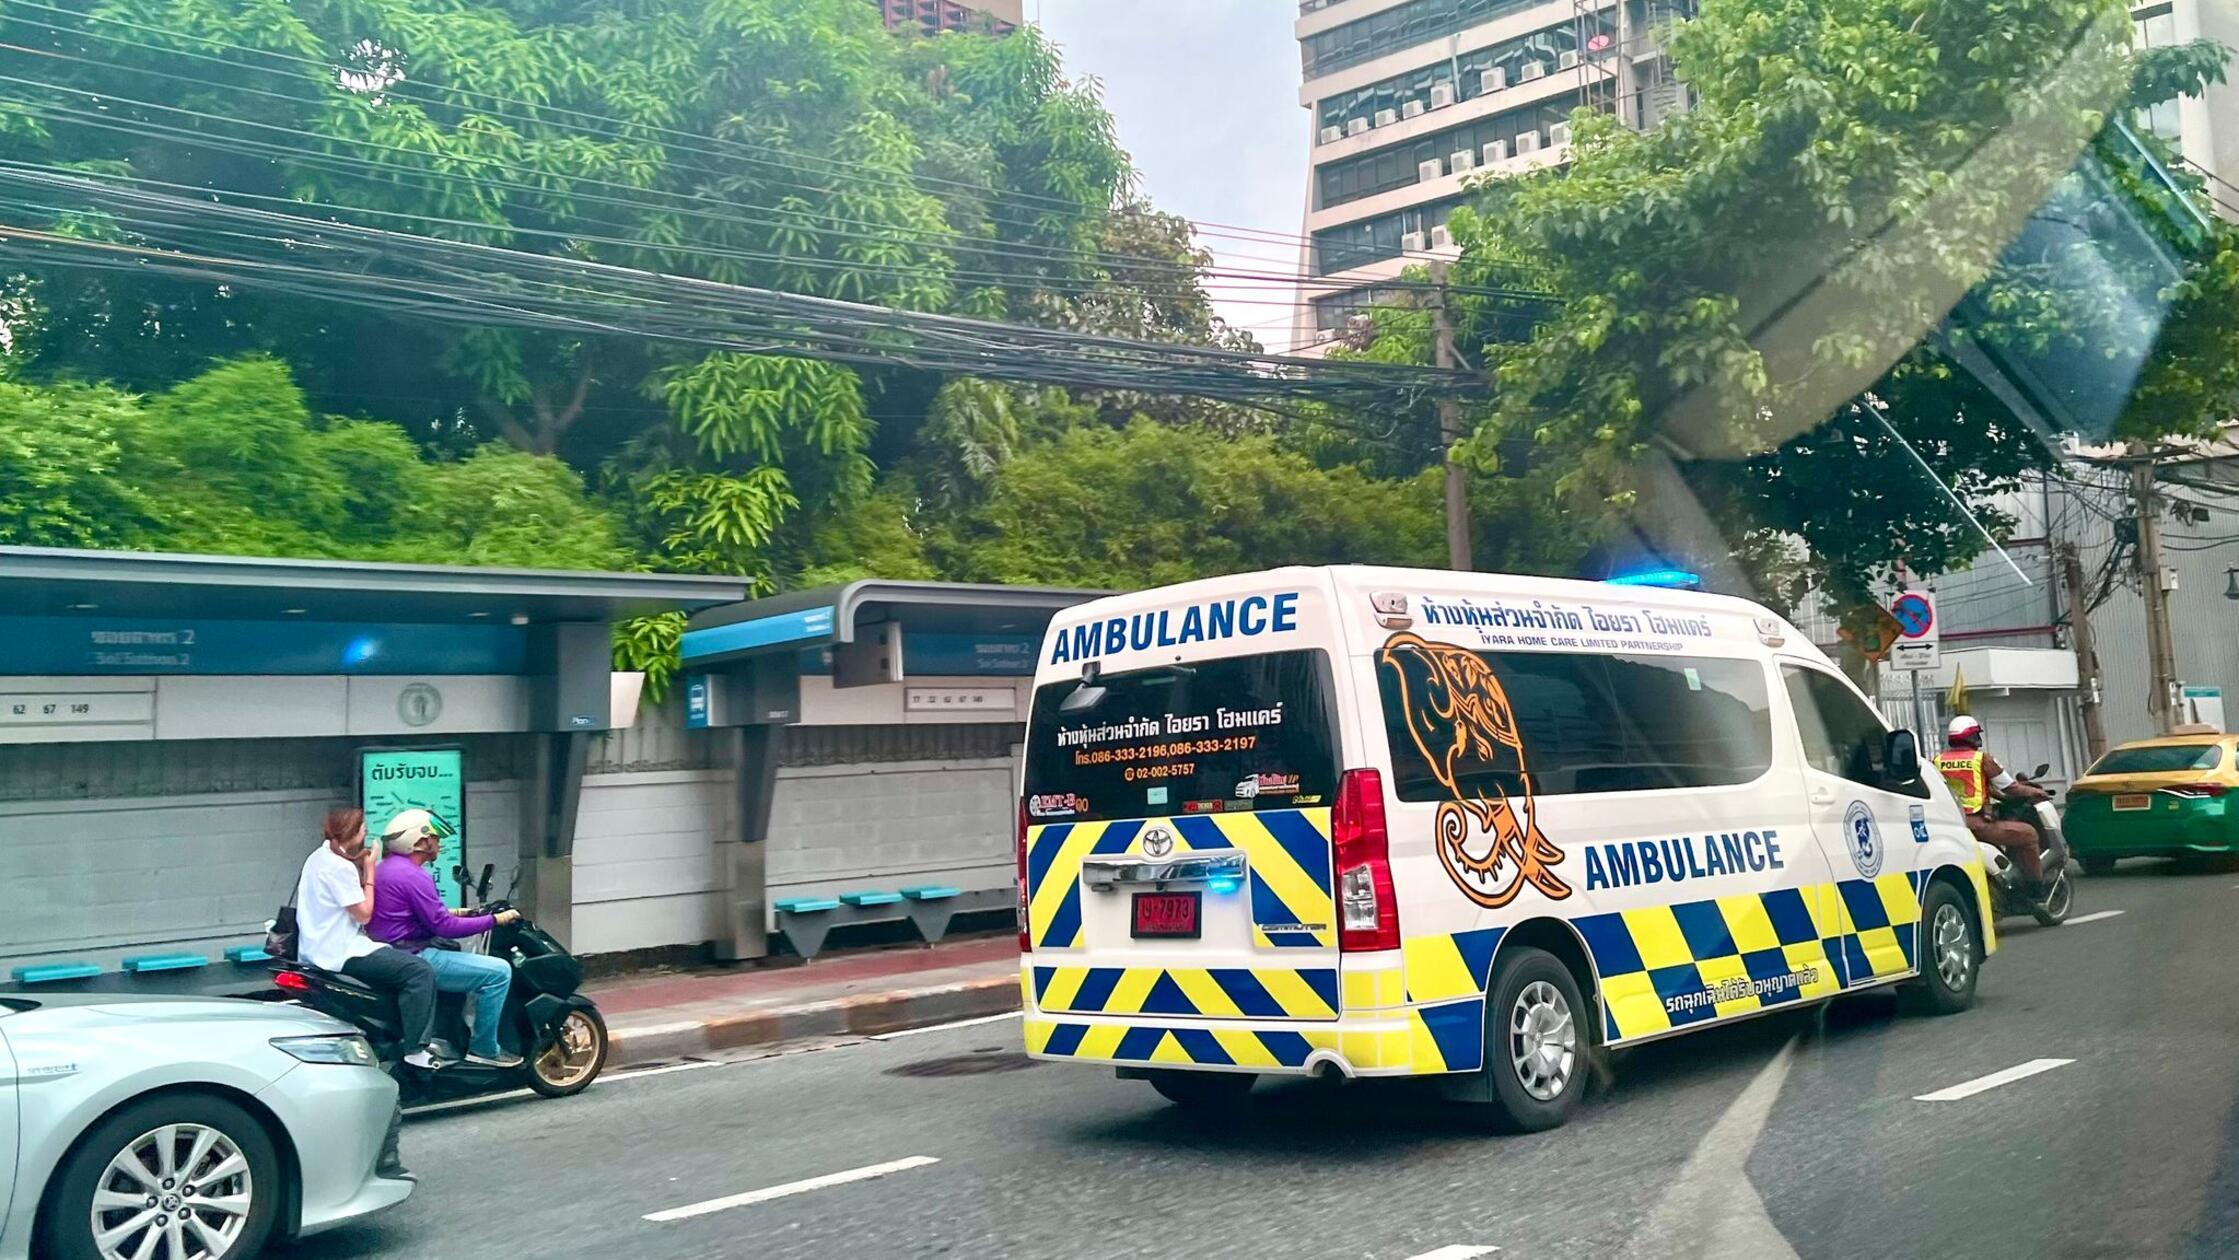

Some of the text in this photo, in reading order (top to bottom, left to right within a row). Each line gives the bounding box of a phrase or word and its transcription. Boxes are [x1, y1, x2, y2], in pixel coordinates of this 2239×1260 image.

[1050, 592, 1299, 666] AMBULANCE
[1421, 596, 1712, 637] ห้างหุ้นส่วนจำกัด ไอยรา โฮมแคร์
[1481, 634, 1684, 651] IYARA HOME CARE LIMITED PARTNERSHIP
[12, 703, 90, 715] 62 67 149
[1057, 701, 1284, 749] ห้างหุ้นส่วนจำกัด ไอยรา โฮมแคร์
[1136, 763, 1196, 779] 02-002-5757
[1940, 760, 1974, 770] POLICE
[1584, 829, 1785, 891] AMBULANCE
[1665, 963, 1819, 1015] รถฉุกเฉินได้รับอนุญาตแล้ว
